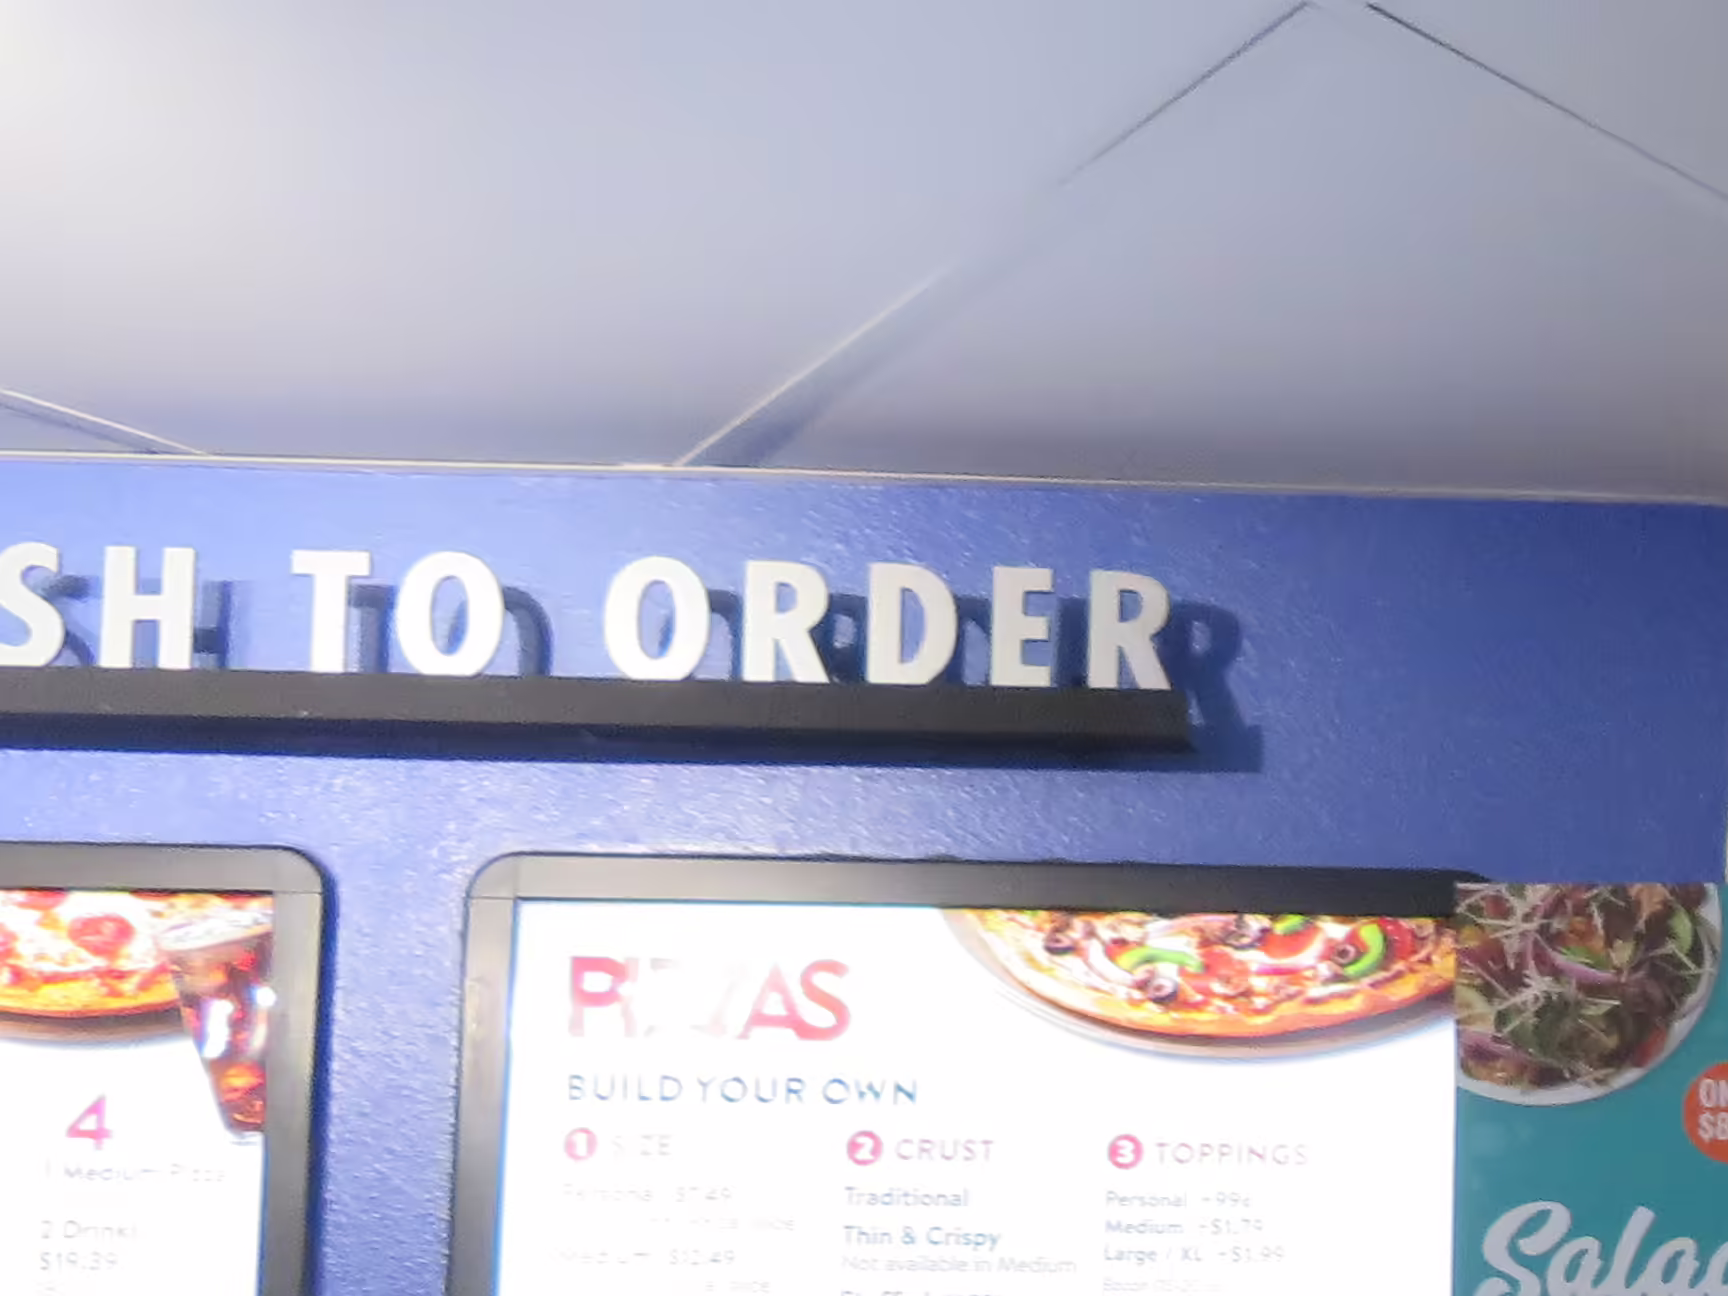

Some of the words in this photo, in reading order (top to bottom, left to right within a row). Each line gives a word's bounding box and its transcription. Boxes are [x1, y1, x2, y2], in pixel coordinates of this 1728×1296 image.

[292, 549, 506, 677] TO
[604, 555, 1173, 692] ORDER
[568, 1074, 684, 1102] BUILD
[697, 1076, 806, 1104] YOUR
[822, 1077, 919, 1106] OWN
[65, 1092, 115, 1151] 4
[895, 1139, 995, 1163] CRUST
[1154, 1142, 1310, 1168] TOPPINGS
[844, 1185, 971, 1208] Traditional
[1104, 1190, 1188, 1209] Personal
[843, 1225, 895, 1246] Thin
[899, 1226, 917, 1246] &
[925, 1226, 1001, 1252] Crispy
[1104, 1218, 1186, 1235] Medium
[997, 1257, 1078, 1275] Medium
[1102, 1246, 1157, 1268] Large
